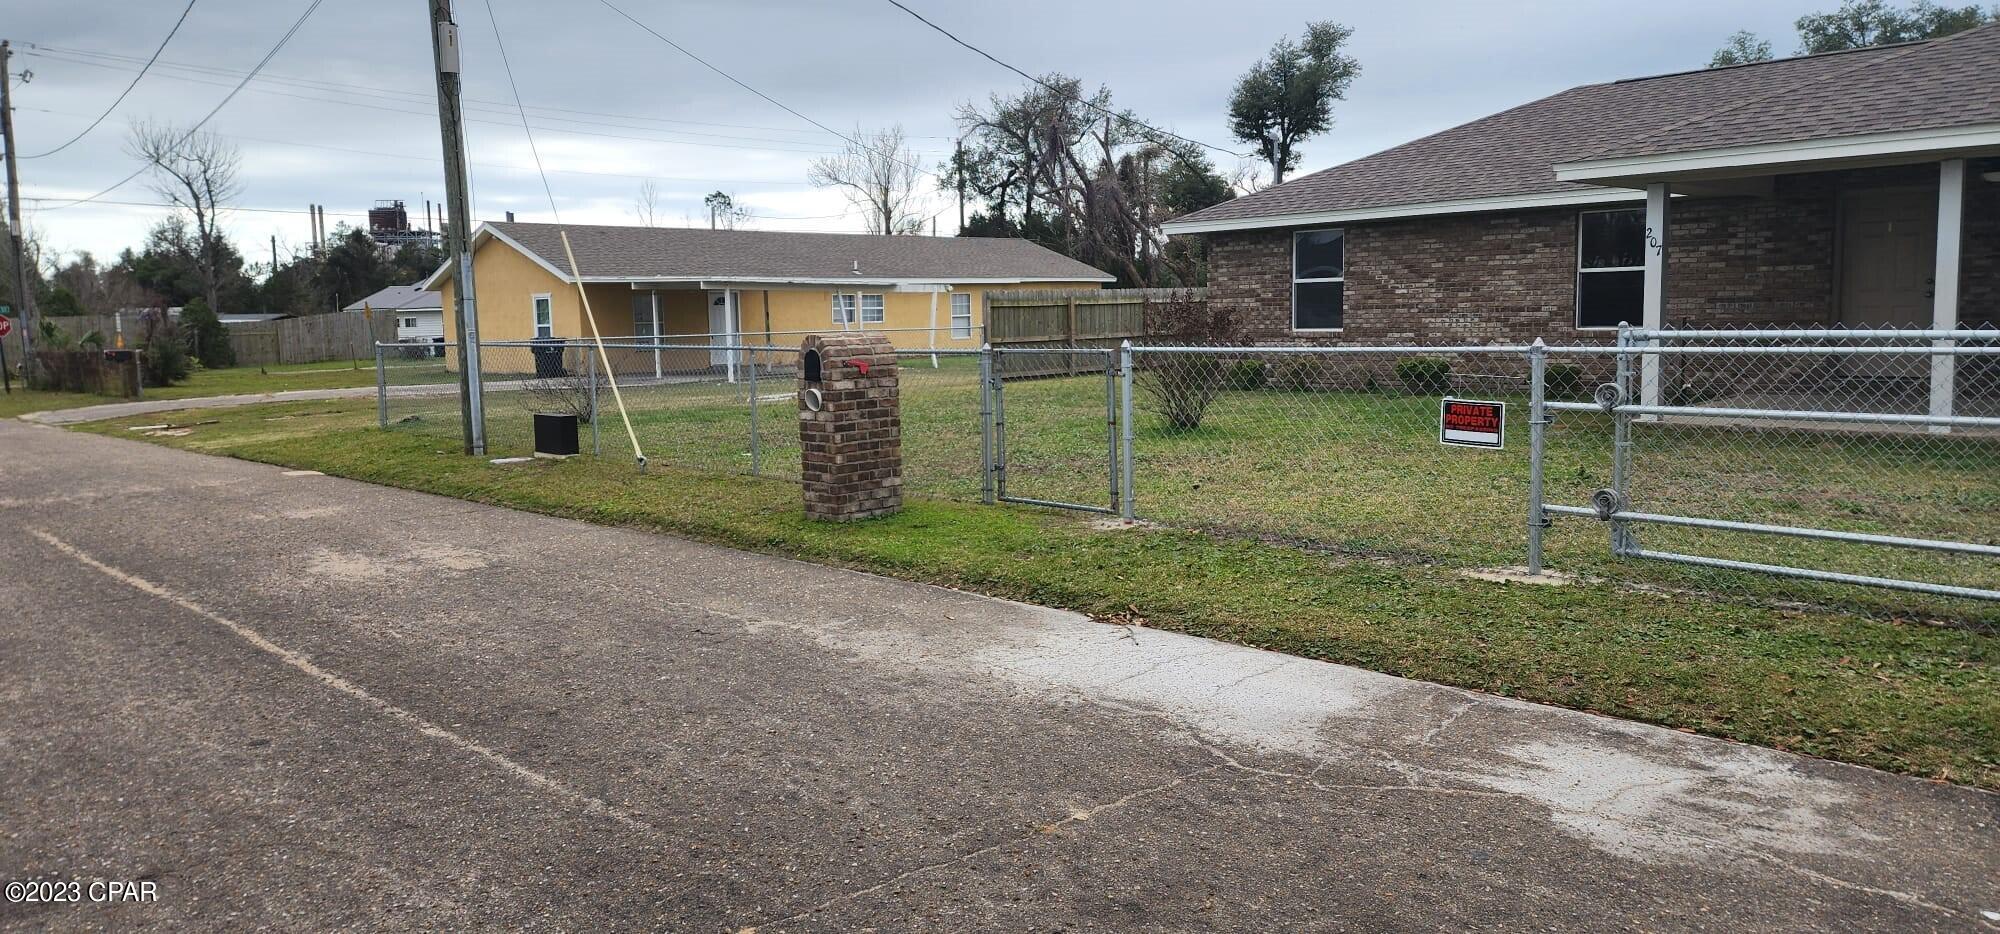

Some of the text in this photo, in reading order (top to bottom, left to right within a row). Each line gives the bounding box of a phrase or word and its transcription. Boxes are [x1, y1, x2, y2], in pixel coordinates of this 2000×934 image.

[1646, 227, 1662, 257] 207
[1450, 404, 1493, 417] PRIVATE
[1446, 413, 1499, 428] PROPERTY
